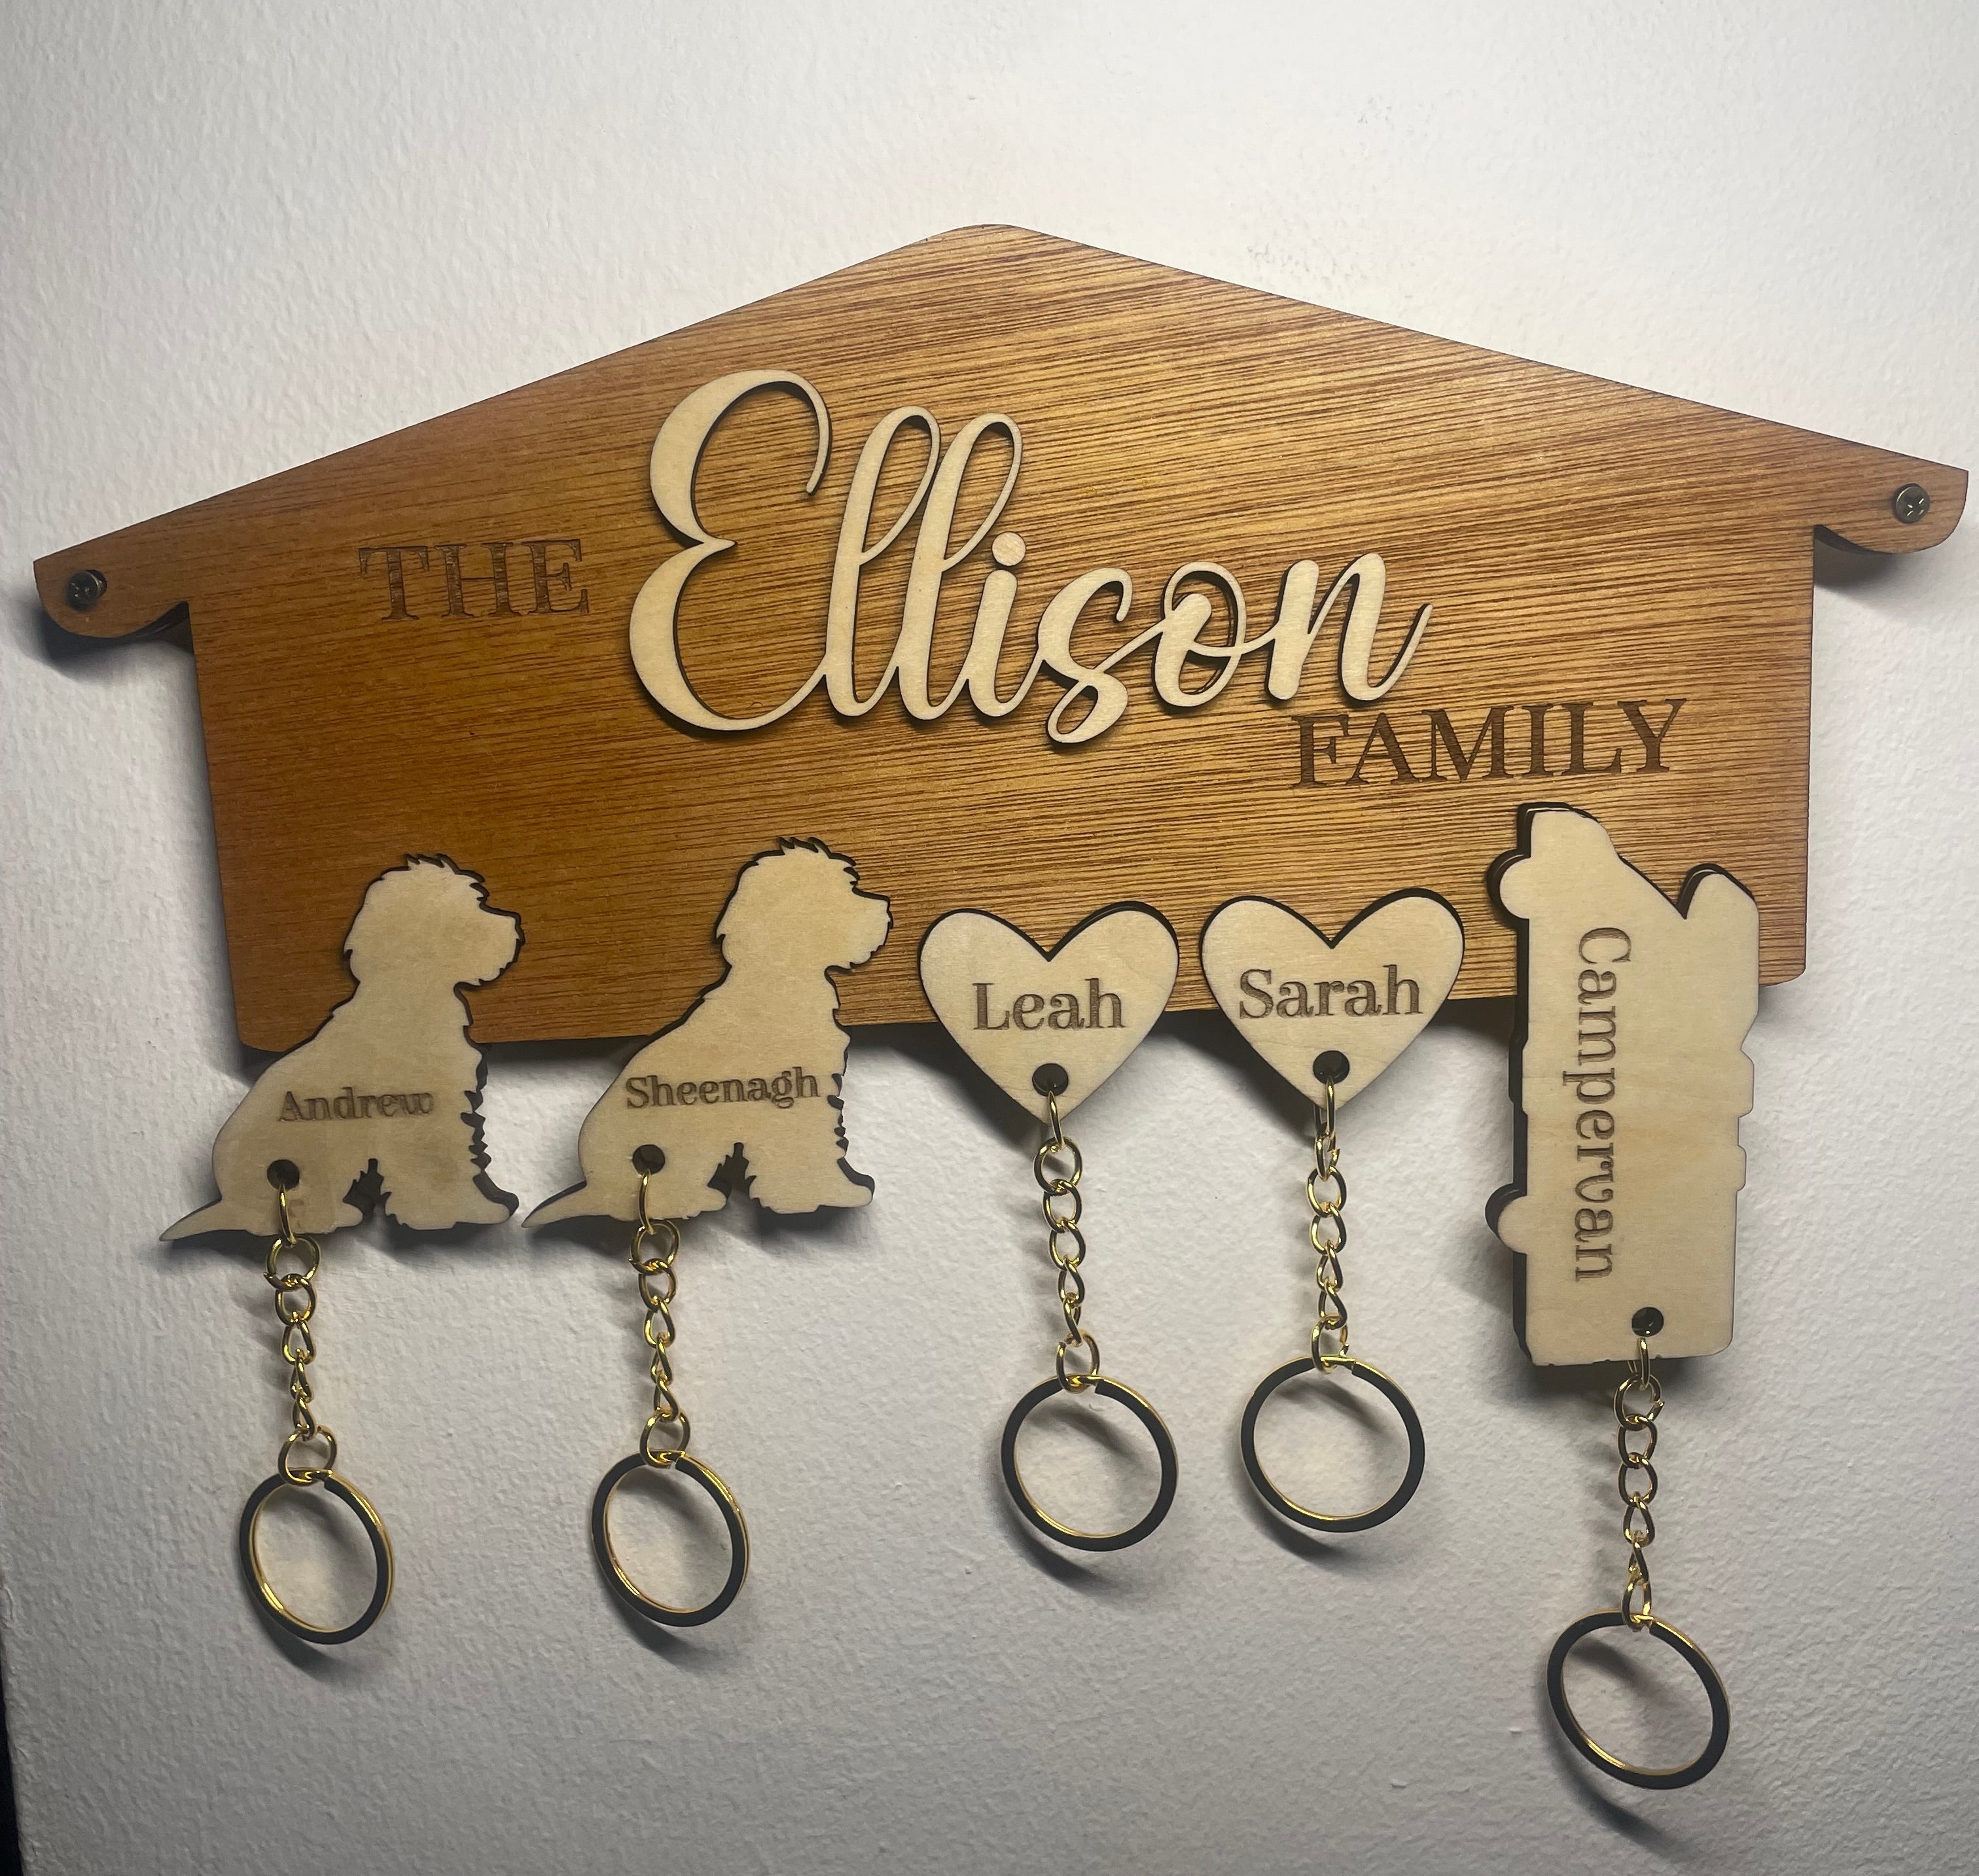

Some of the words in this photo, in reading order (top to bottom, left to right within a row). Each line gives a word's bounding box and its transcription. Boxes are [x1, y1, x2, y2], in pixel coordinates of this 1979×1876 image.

[358, 538, 589, 620] THE
[629, 369, 1432, 745] Ellison
[1291, 698, 1686, 788] FAMILY
[972, 977, 1126, 1031] Leah
[1238, 963, 1424, 1019] Sarah
[277, 1086, 435, 1122] Andrew
[625, 1066, 822, 1110] Sheenagh
[1562, 927, 1631, 1282] Campervan
